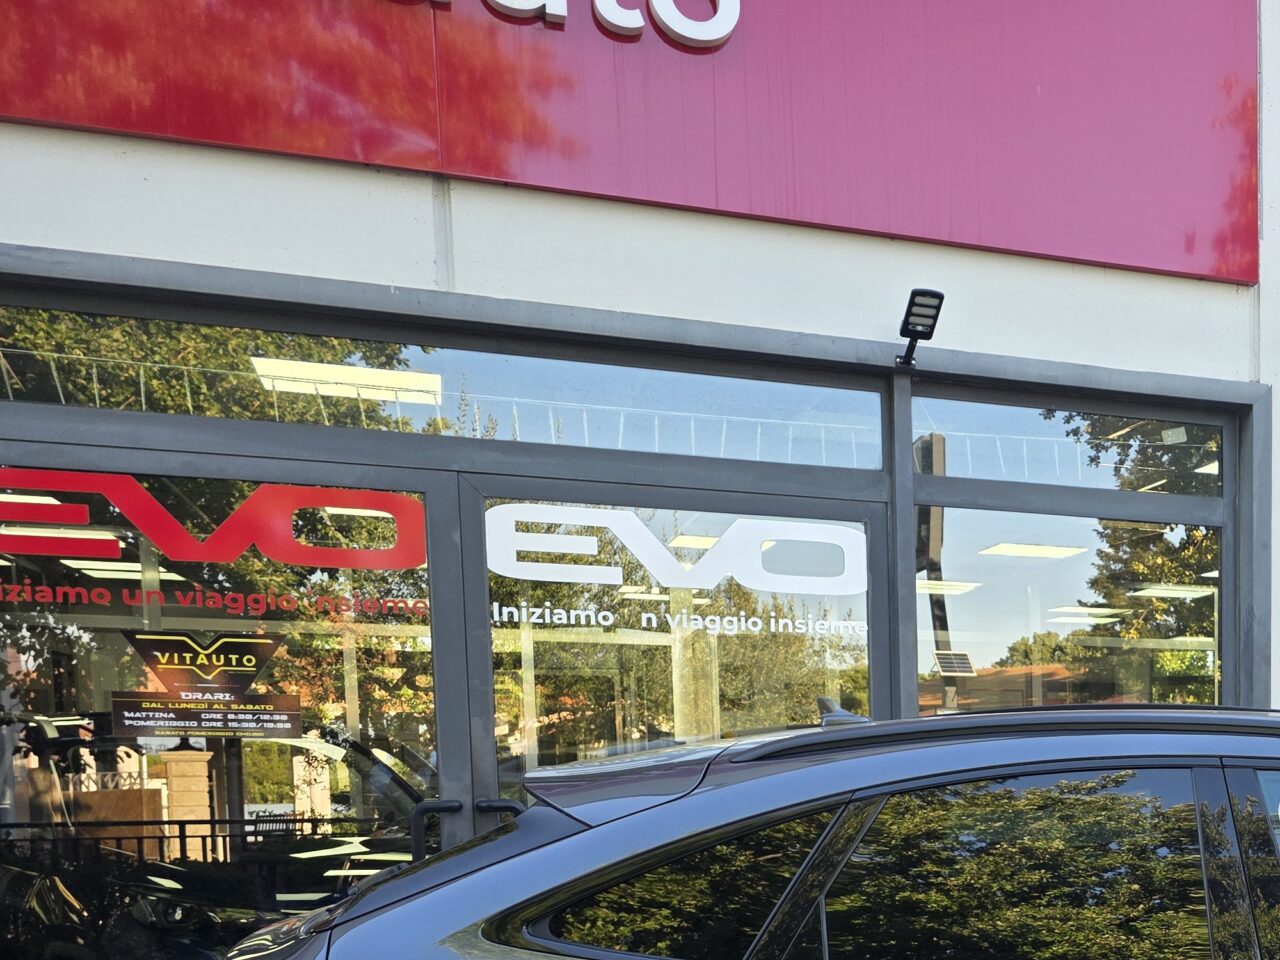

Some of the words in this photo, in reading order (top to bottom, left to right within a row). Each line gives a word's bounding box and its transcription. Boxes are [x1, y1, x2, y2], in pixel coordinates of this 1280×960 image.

[484, 503, 868, 596] EVO
[122, 587, 165, 607] un
[174, 584, 298, 616] viaggio
[306, 589, 429, 615] nsieme
[492, 601, 615, 626] Iniziamo
[665, 608, 763, 635] viaggio
[770, 611, 868, 635] insieme
[153, 651, 257, 666] VITAUTO
